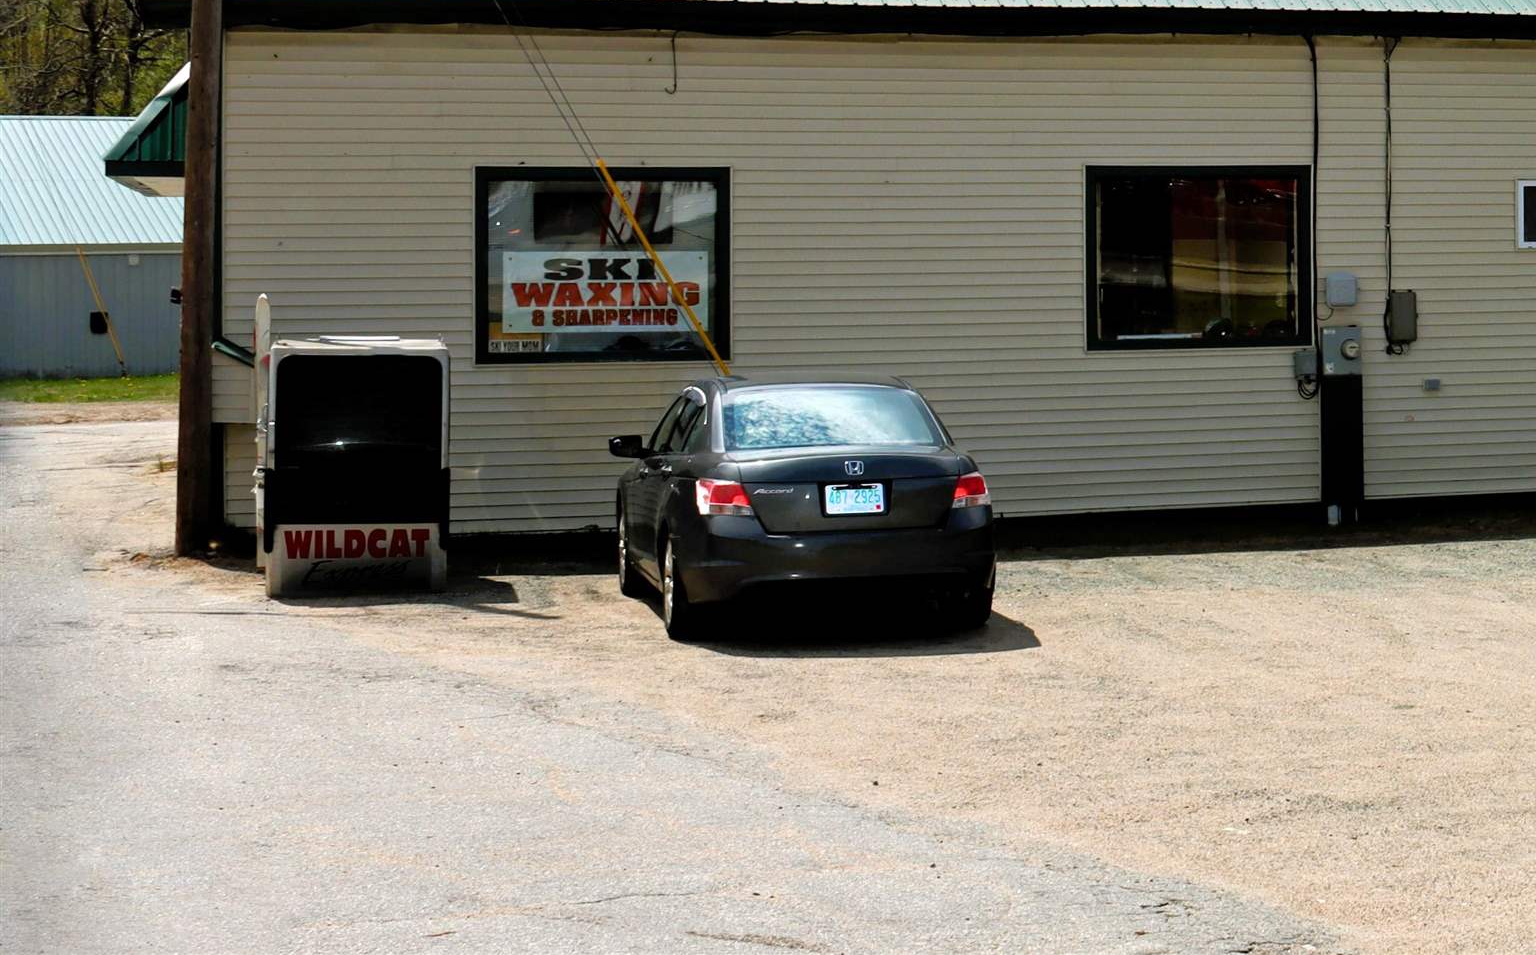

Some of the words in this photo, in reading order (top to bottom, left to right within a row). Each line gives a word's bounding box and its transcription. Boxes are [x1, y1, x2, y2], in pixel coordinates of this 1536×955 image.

[543, 258, 657, 281] SKI
[511, 281, 700, 307] WAXING
[531, 309, 545, 327] &
[552, 308, 678, 326] SHARPENING
[854, 489, 881, 504] 2925
[284, 529, 430, 559] WILDCAT
